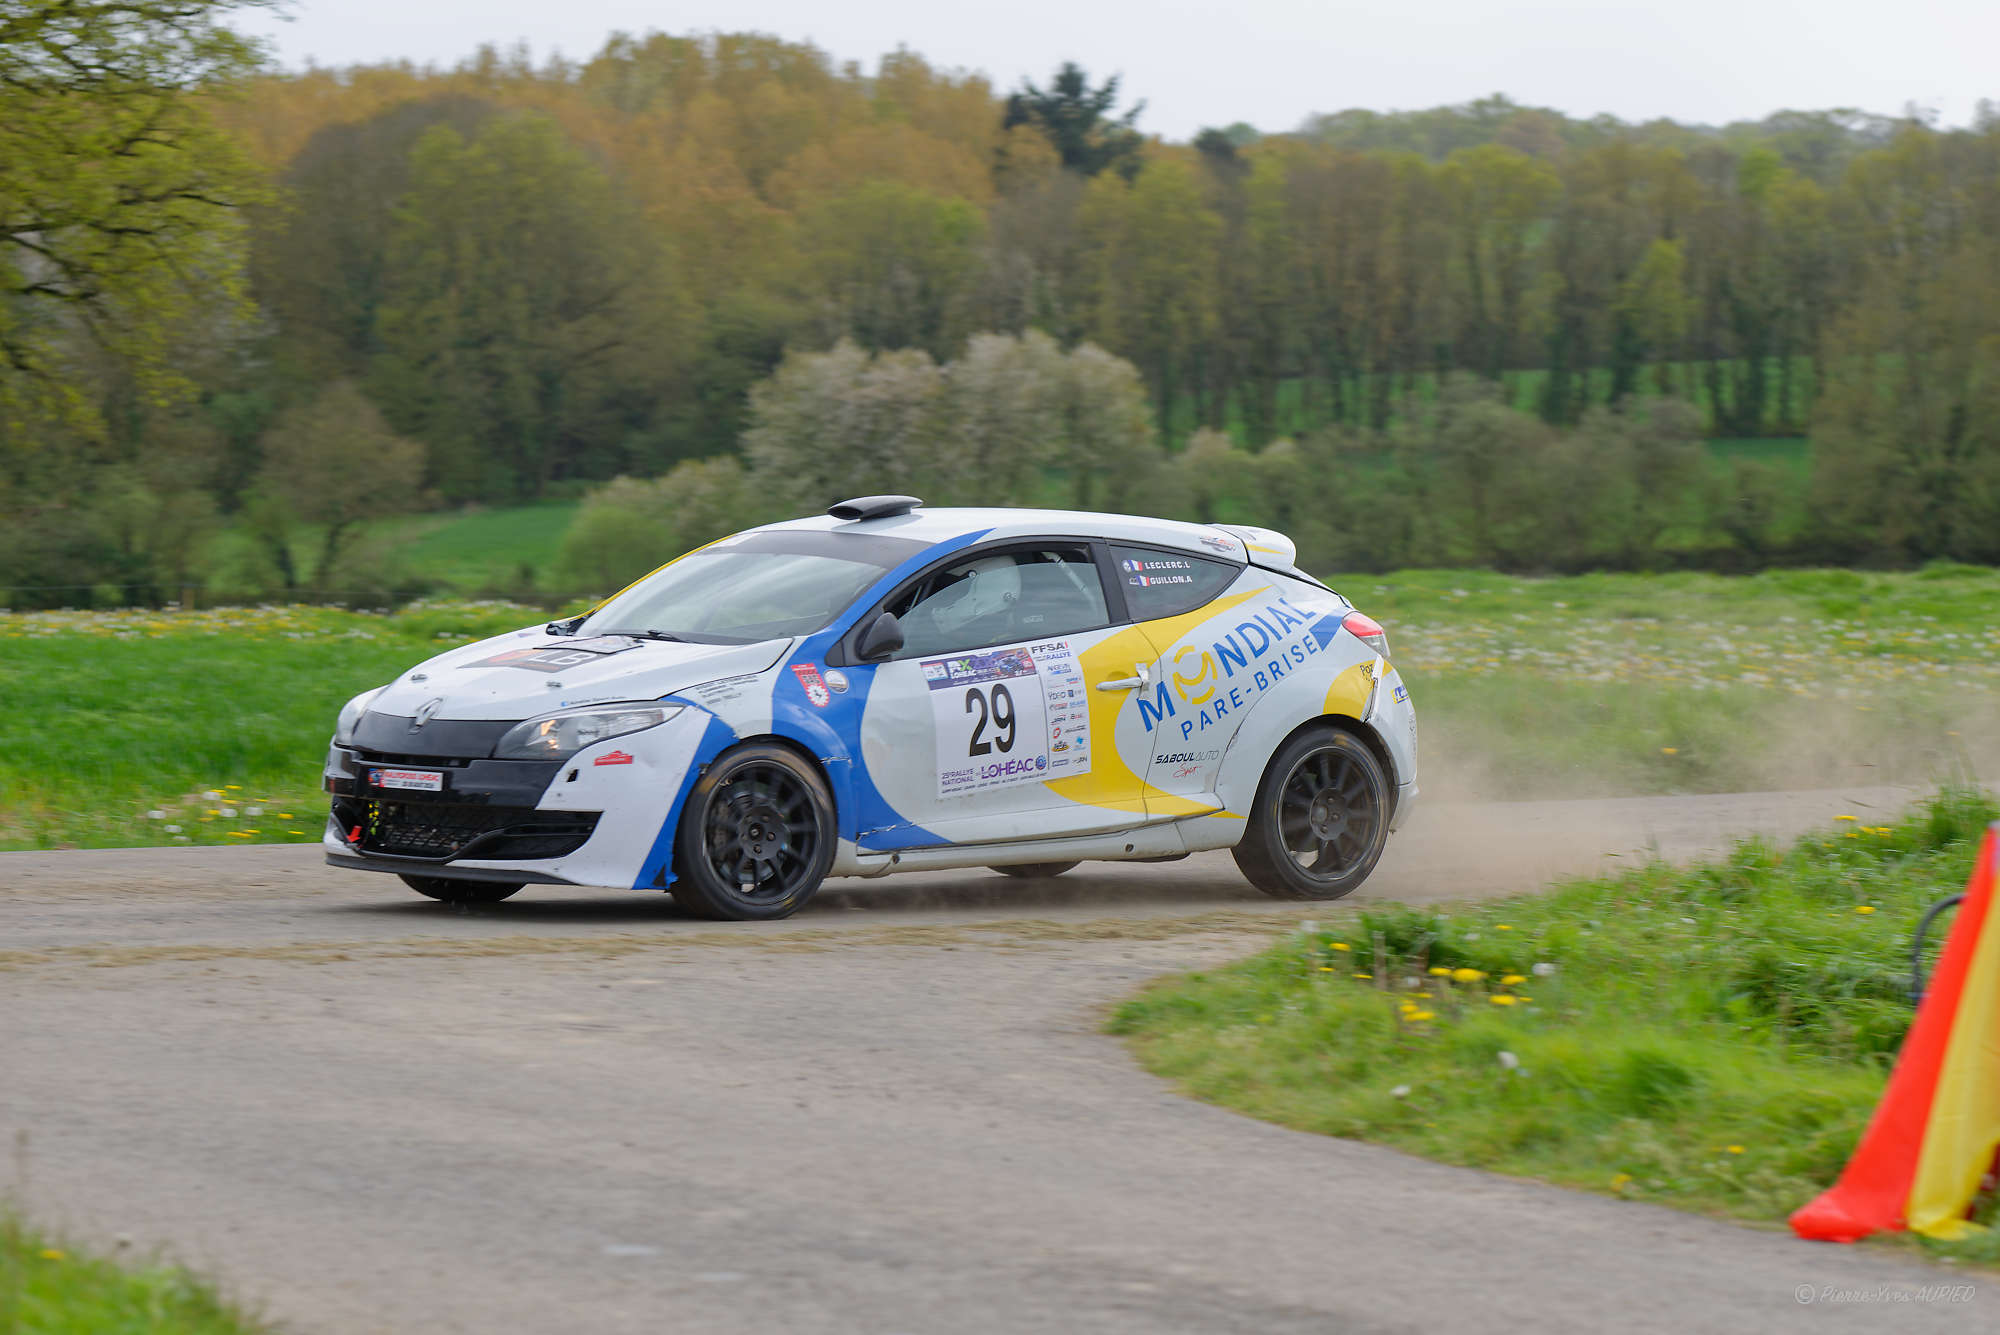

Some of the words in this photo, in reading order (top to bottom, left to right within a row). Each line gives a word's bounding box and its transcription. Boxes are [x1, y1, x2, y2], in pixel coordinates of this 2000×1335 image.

[1144, 561, 1191, 570] LECLERC.L
[1150, 575, 1193, 585] GUILLON.A
[1180, 635, 1318, 742] PARE-BRISE
[965, 683, 1016, 757] 29
[981, 758, 1034, 780] LOHÉAC
[942, 776, 974, 786] NATIONAL
